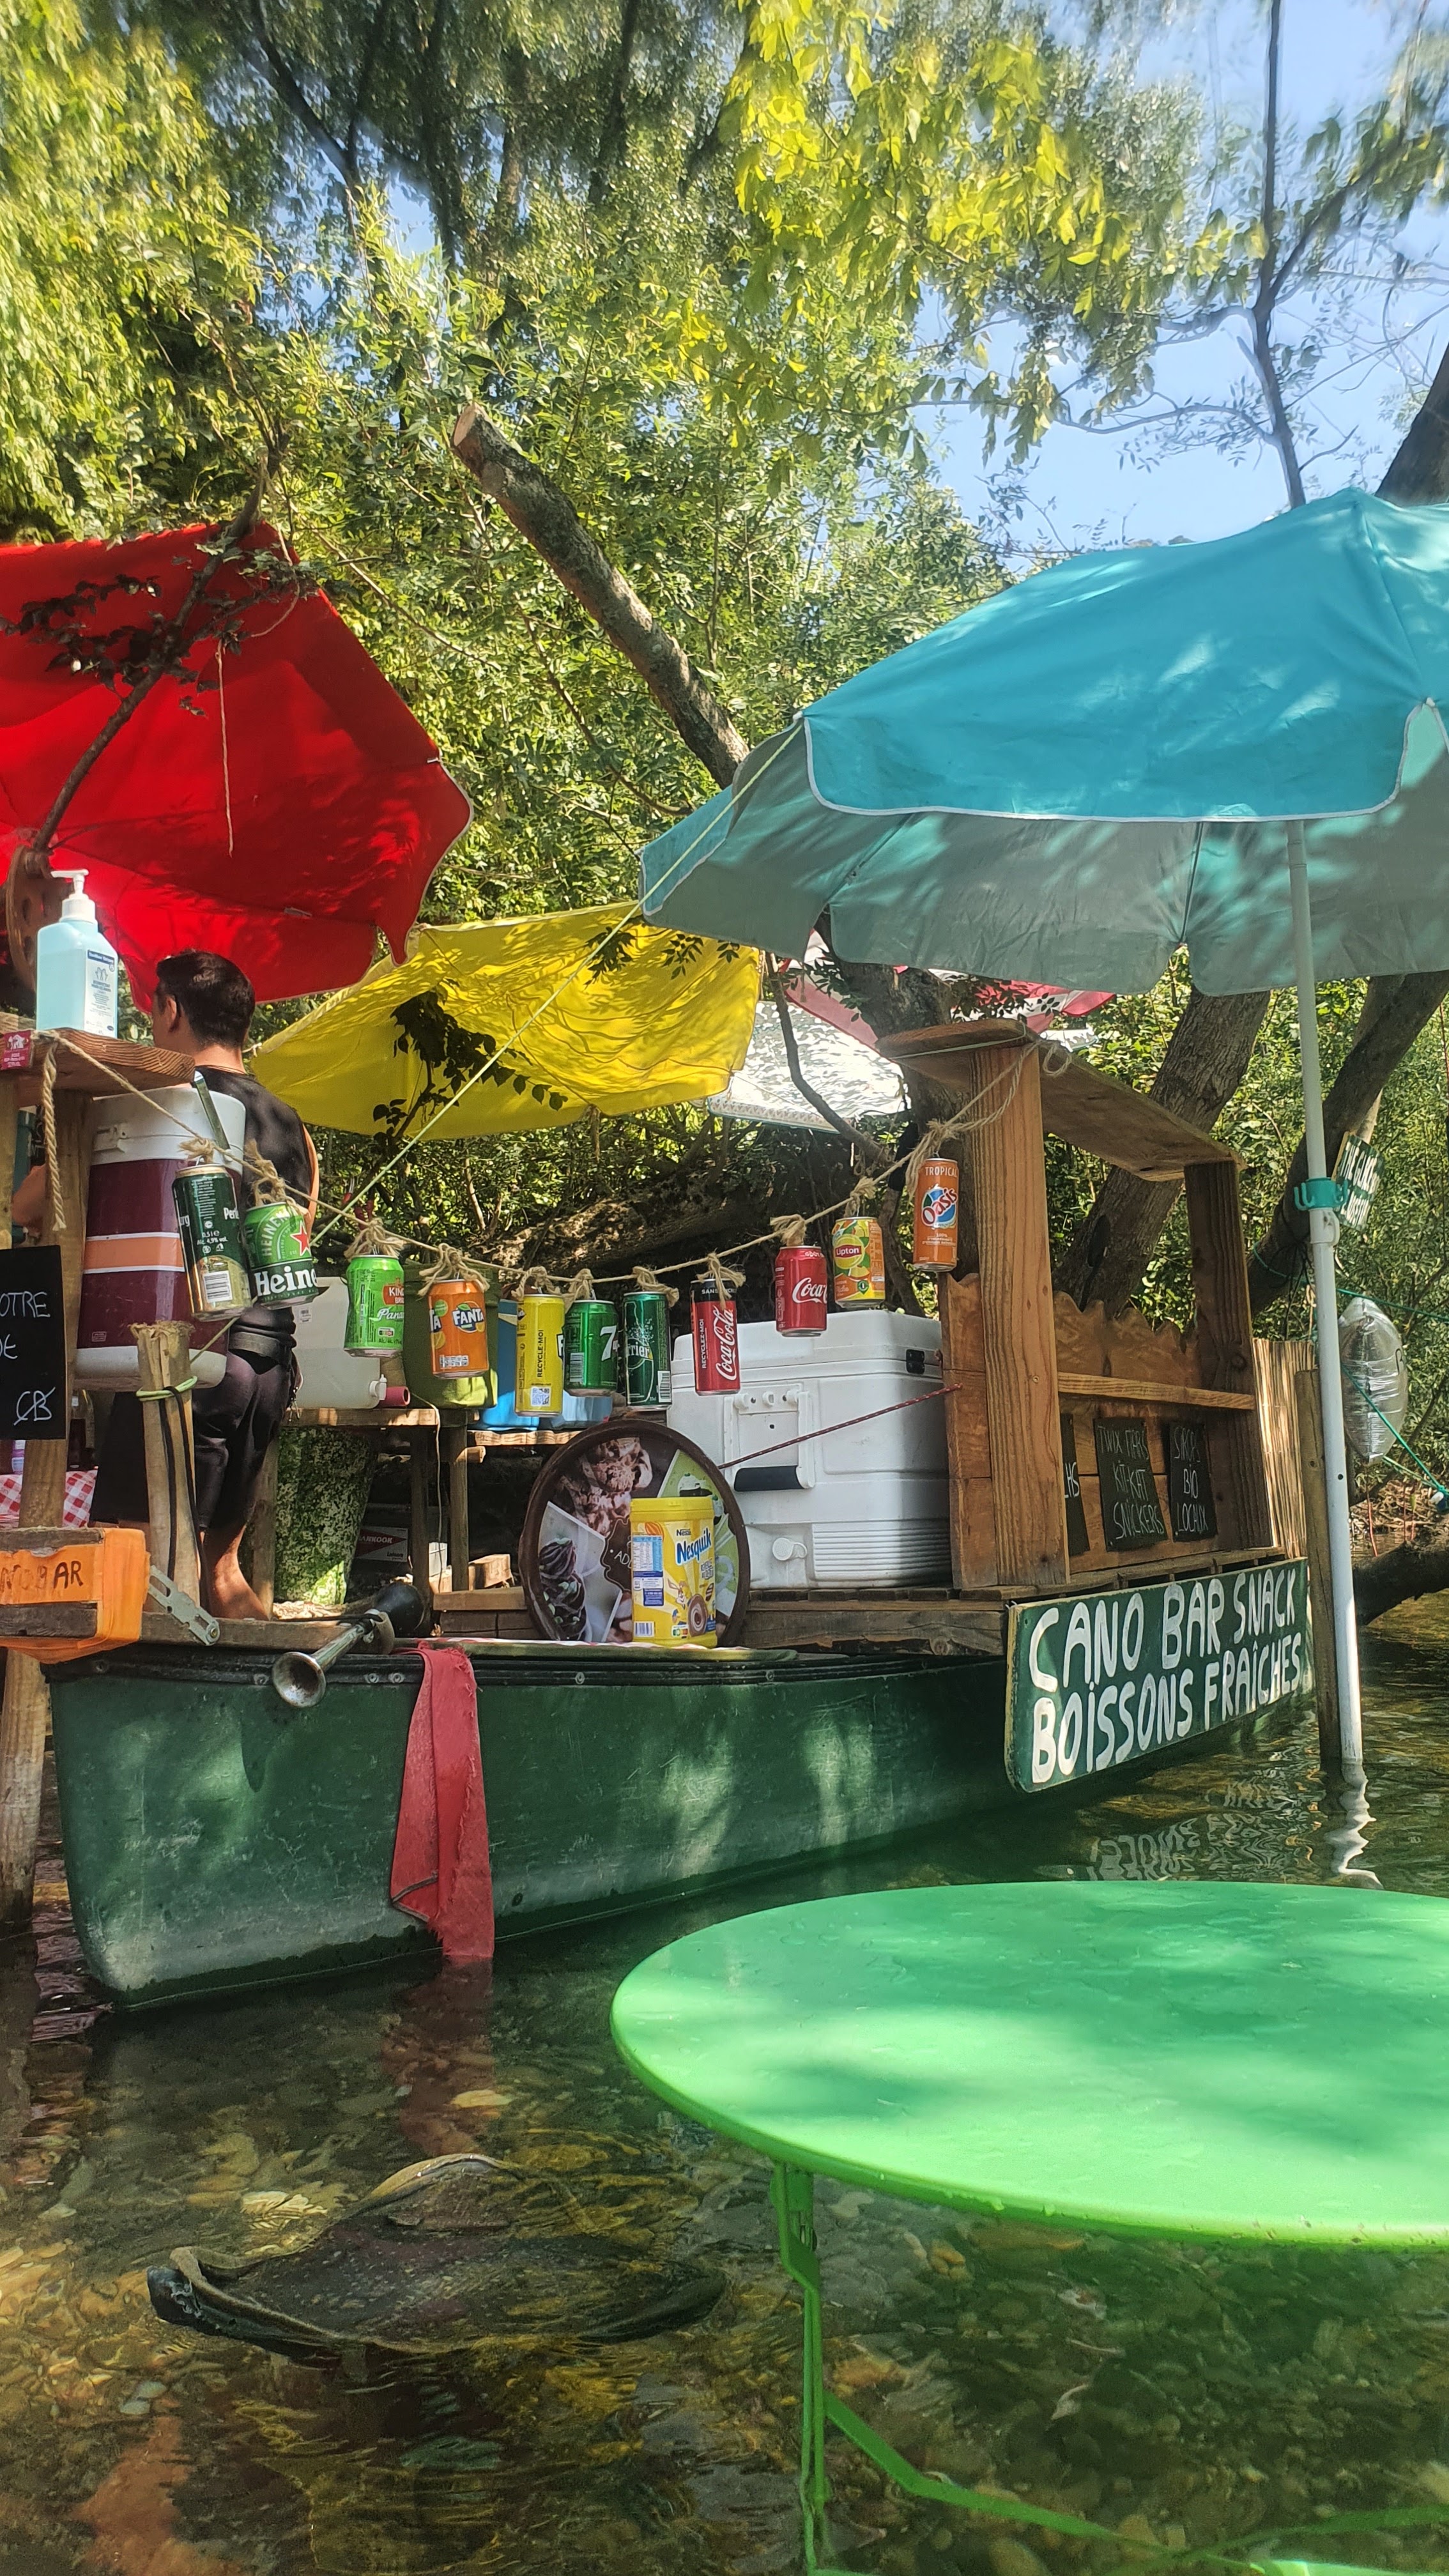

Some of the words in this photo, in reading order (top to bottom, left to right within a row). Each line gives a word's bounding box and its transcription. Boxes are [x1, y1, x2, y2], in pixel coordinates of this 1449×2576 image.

[925, 1167, 958, 1177] TROPICAL
[922, 1187, 958, 1225] Oasis
[836, 1247, 859, 1256] Lipton
[452, 1308, 484, 1326] FANTA
[1098, 1425, 1123, 1454] TWIX
[677, 1528, 712, 1564] Nesquik
[1029, 1592, 1144, 1693] CANO
[1162, 1578, 1225, 1669] BAR
[1233, 1568, 1296, 1644] SNACK
[1204, 1632, 1302, 1731] FRAÎCHES
